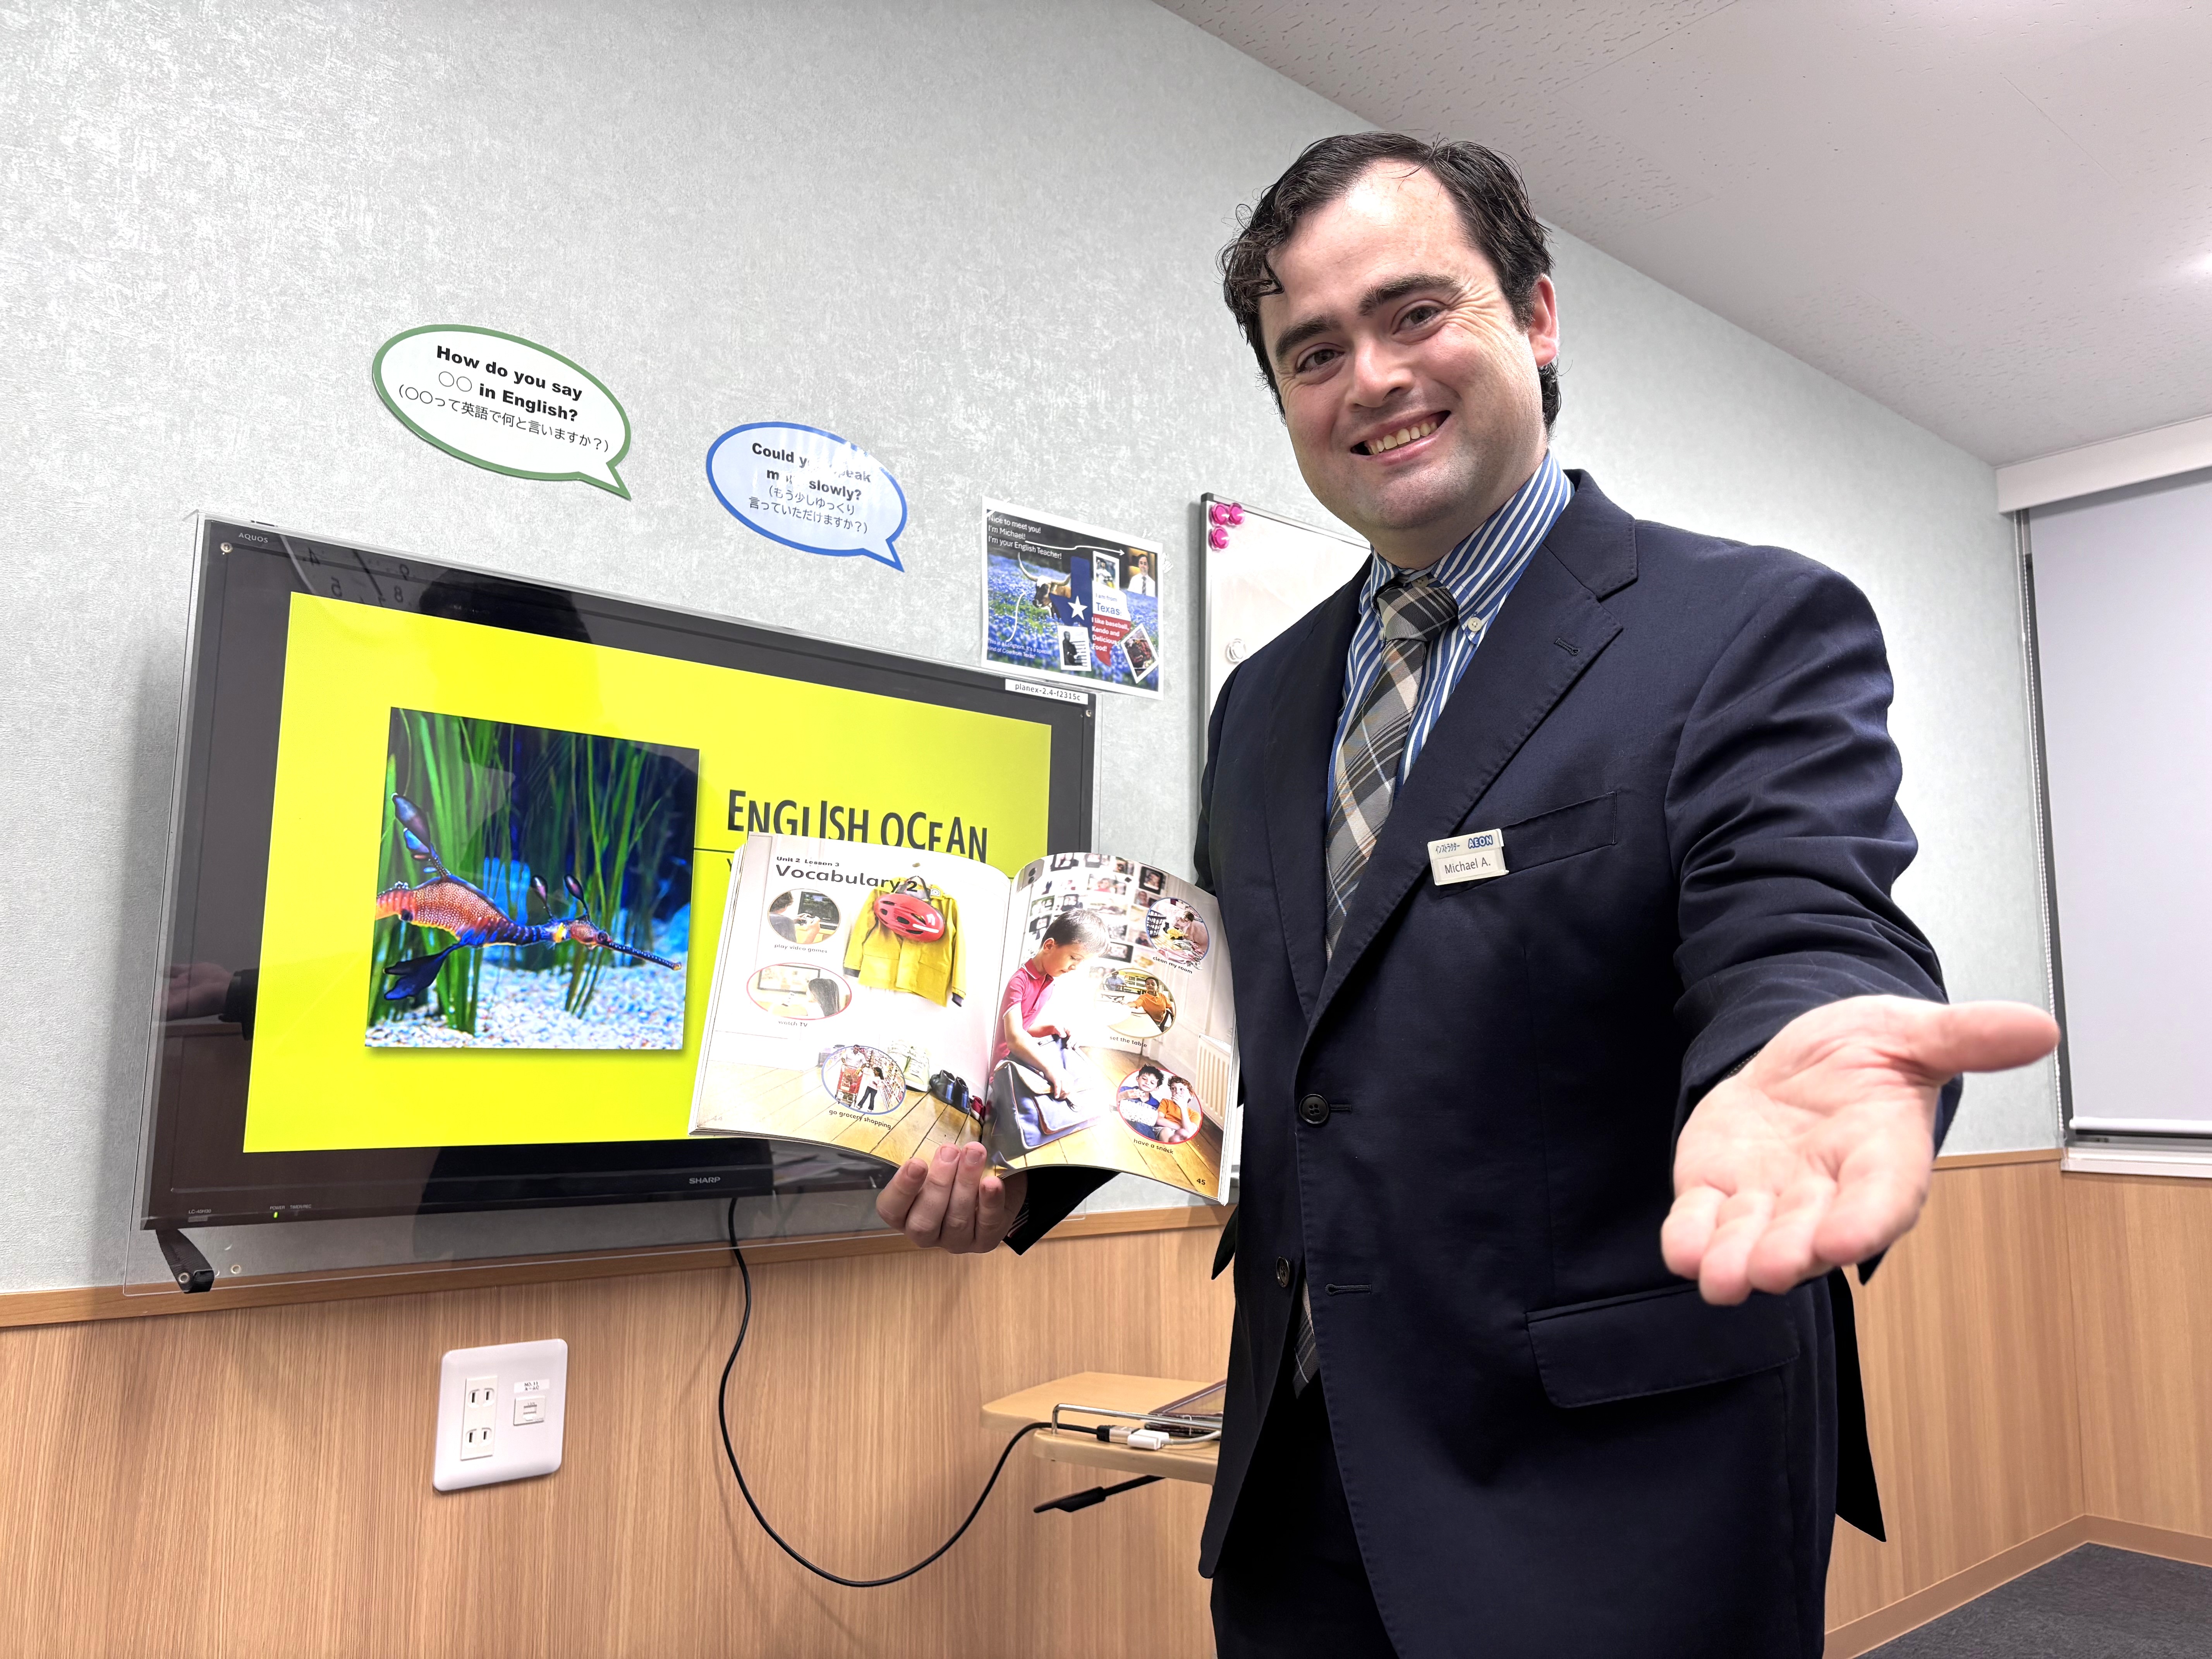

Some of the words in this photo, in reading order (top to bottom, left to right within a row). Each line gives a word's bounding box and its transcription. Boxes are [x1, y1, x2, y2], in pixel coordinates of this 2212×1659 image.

[436, 345, 480, 369] How
[485, 361, 508, 377] do
[514, 371, 546, 389] you
[551, 380, 582, 402] say
[479, 383, 496, 399] in
[503, 390, 578, 422] English?
[752, 443, 794, 464] Could
[809, 479, 862, 501] slowly?
[988, 515, 1003, 524] Nice
[1012, 521, 1027, 530] meet
[1028, 526, 1041, 534] you!
[238, 532, 268, 543] AQUOS
[1000, 527, 1026, 539] Michael!
[1014, 542, 1036, 553] English
[1037, 546, 1062, 560] Teacher!
[1092, 625, 1109, 634] Kendo
[1105, 620, 1130, 631] baseball,
[1092, 643, 1108, 652] Food!
[1015, 684, 1080, 701] planex-2.4-f2315c
[1435, 842, 1460, 855] インストラクター
[1468, 834, 1493, 849] AEON
[804, 859, 833, 867] Lesson
[1444, 858, 1478, 874] Michael
[1482, 857, 1491, 867] A.
[776, 864, 901, 893] Vocabulary
[907, 880, 918, 893] 2
[1178, 965, 1193, 974] room
[839, 1111, 863, 1122] grocery
[864, 1116, 891, 1130] shopping
[1133, 1138, 1149, 1146] have
[1156, 1145, 1174, 1154] snack
[689, 1176, 721, 1184] SHARP
